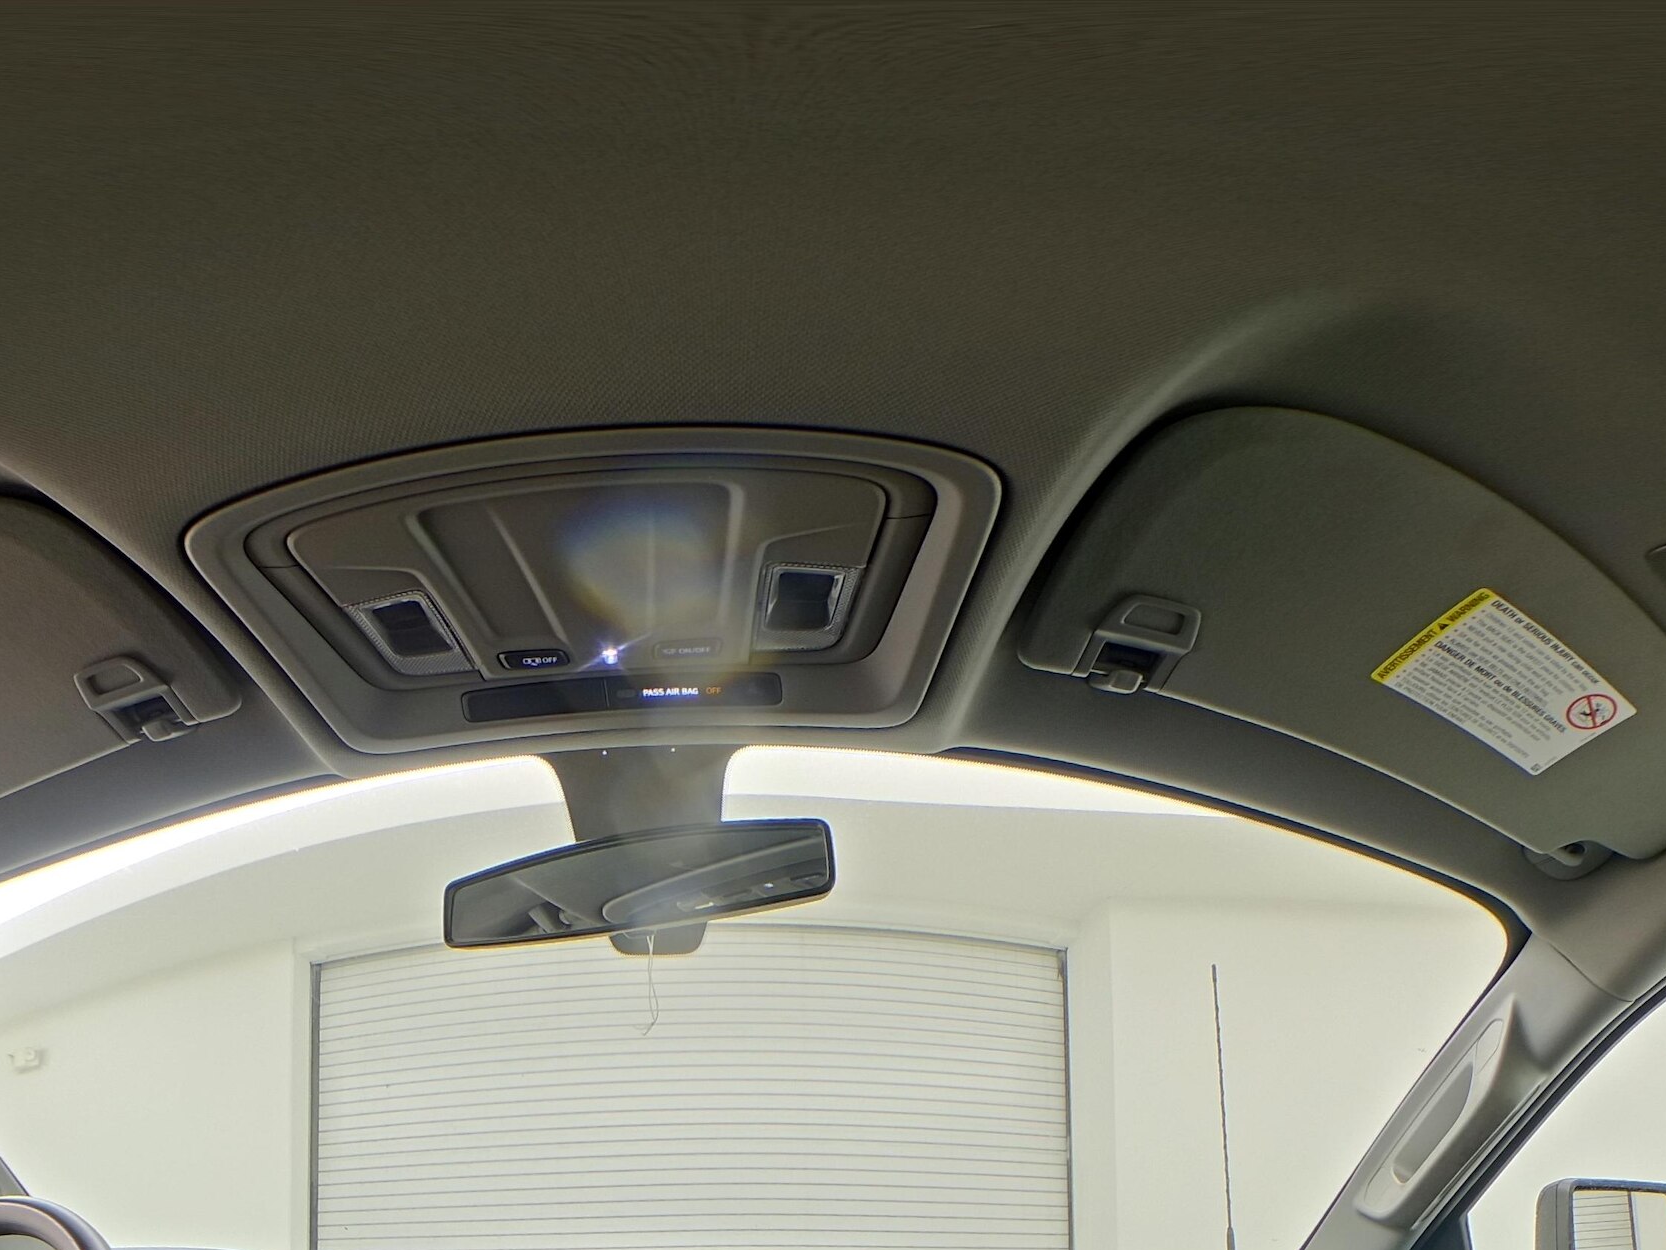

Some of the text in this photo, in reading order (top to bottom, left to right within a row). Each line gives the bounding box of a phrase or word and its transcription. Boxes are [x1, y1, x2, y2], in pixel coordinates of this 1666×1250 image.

[1447, 591, 1490, 622] WARNING
[1491, 600, 1517, 623] DEATH
[642, 686, 723, 697] PASS AIR BAG OFF
[1434, 640, 1466, 662] DANGER
[1474, 665, 1497, 681] MORT
[1511, 690, 1546, 718] BLESSURES
